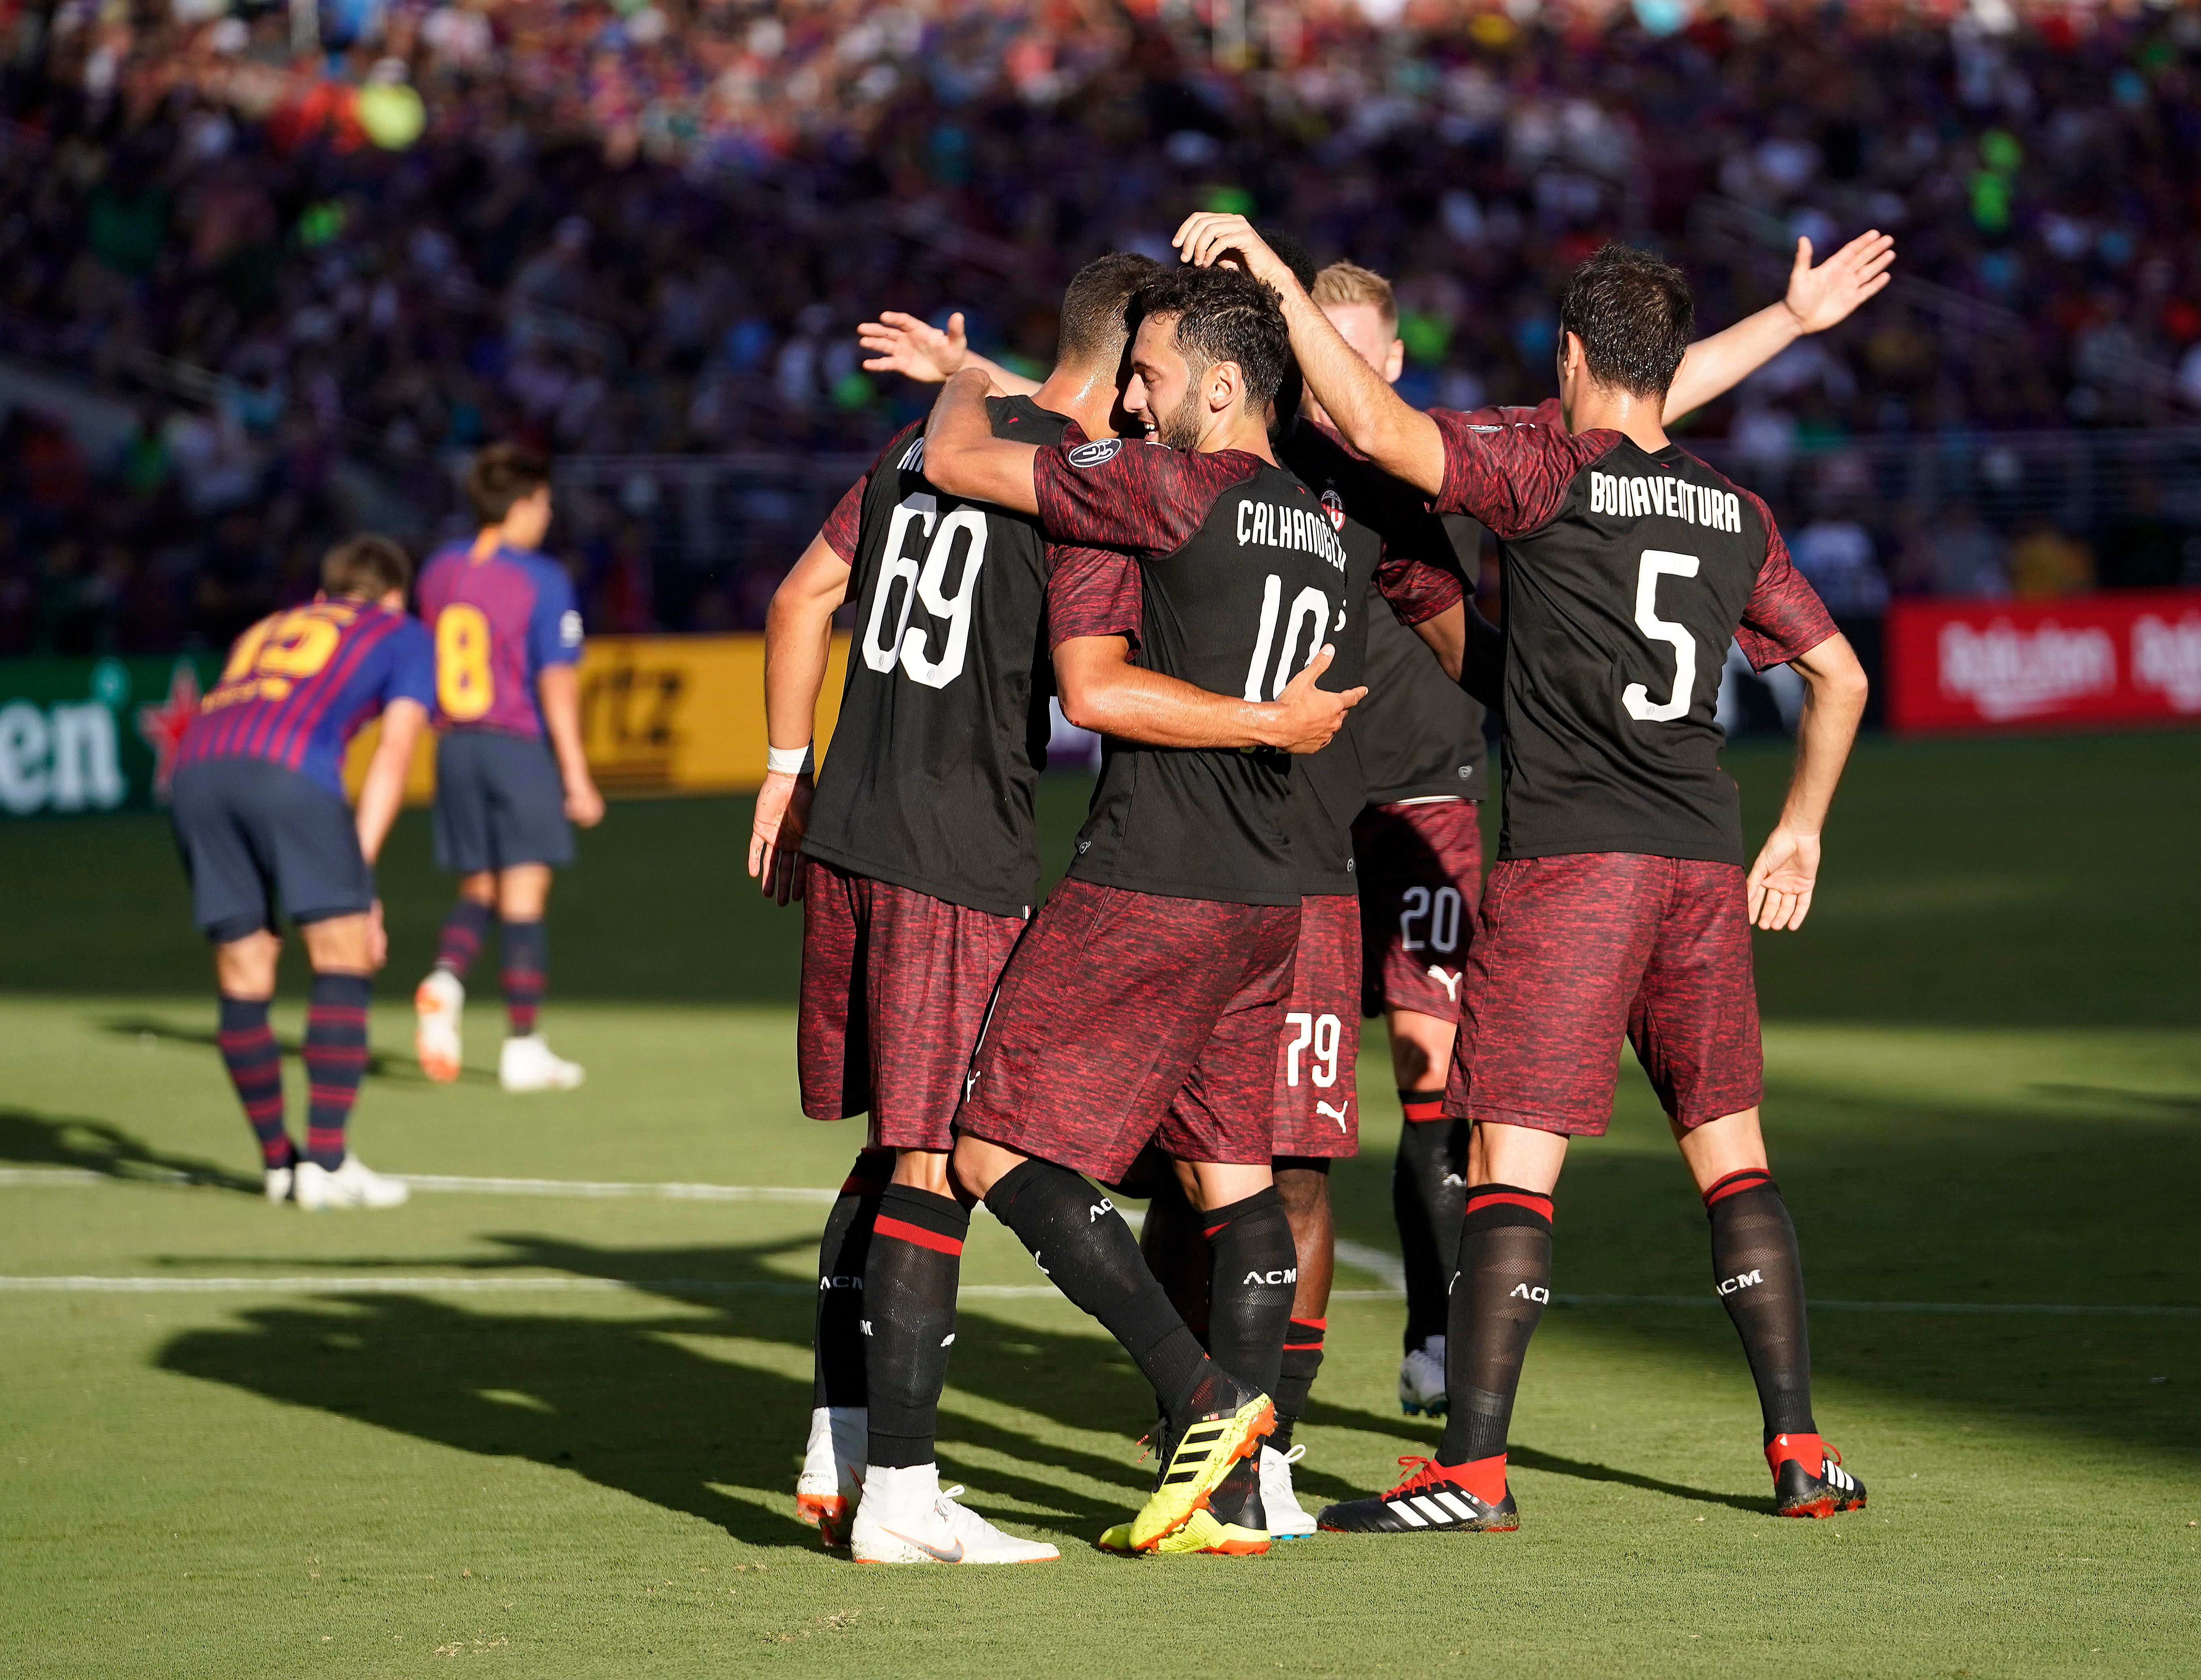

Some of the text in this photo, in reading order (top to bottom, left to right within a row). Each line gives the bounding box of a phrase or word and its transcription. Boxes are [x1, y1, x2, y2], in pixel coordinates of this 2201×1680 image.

[1591, 471, 1741, 533] BONAVENTURA
[863, 492, 988, 689] 69
[1622, 549, 1700, 722] 5
[436, 602, 495, 721] 8
[1242, 574, 1330, 704] 10
[0, 699, 125, 812] en
[1400, 886, 1462, 954] 20
[1285, 1012, 1341, 1088] 79
[1090, 1197, 1114, 1223] AC
[1243, 1267, 1297, 1285] ACM
